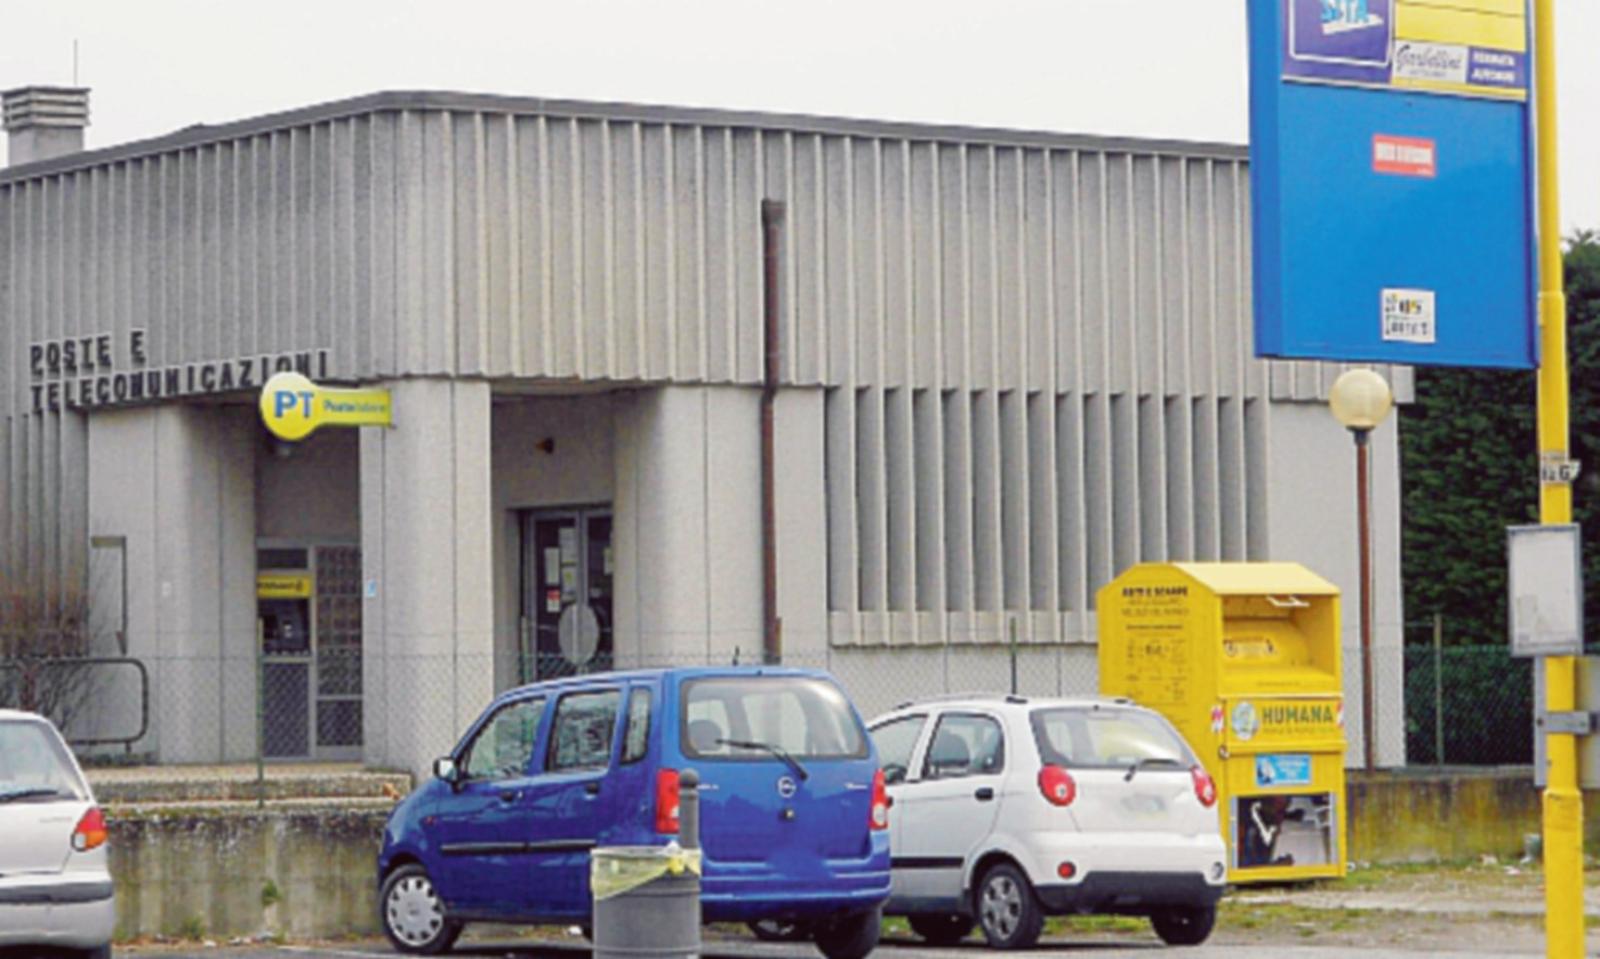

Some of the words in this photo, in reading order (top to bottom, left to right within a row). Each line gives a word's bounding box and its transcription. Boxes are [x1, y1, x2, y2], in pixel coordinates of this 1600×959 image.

[30, 336, 111, 376] POSTE
[130, 330, 145, 364] E
[31, 350, 328, 414] TELECOMUNICAZIONI
[274, 390, 315, 419] PT
[1262, 705, 1334, 725] HUMANA
